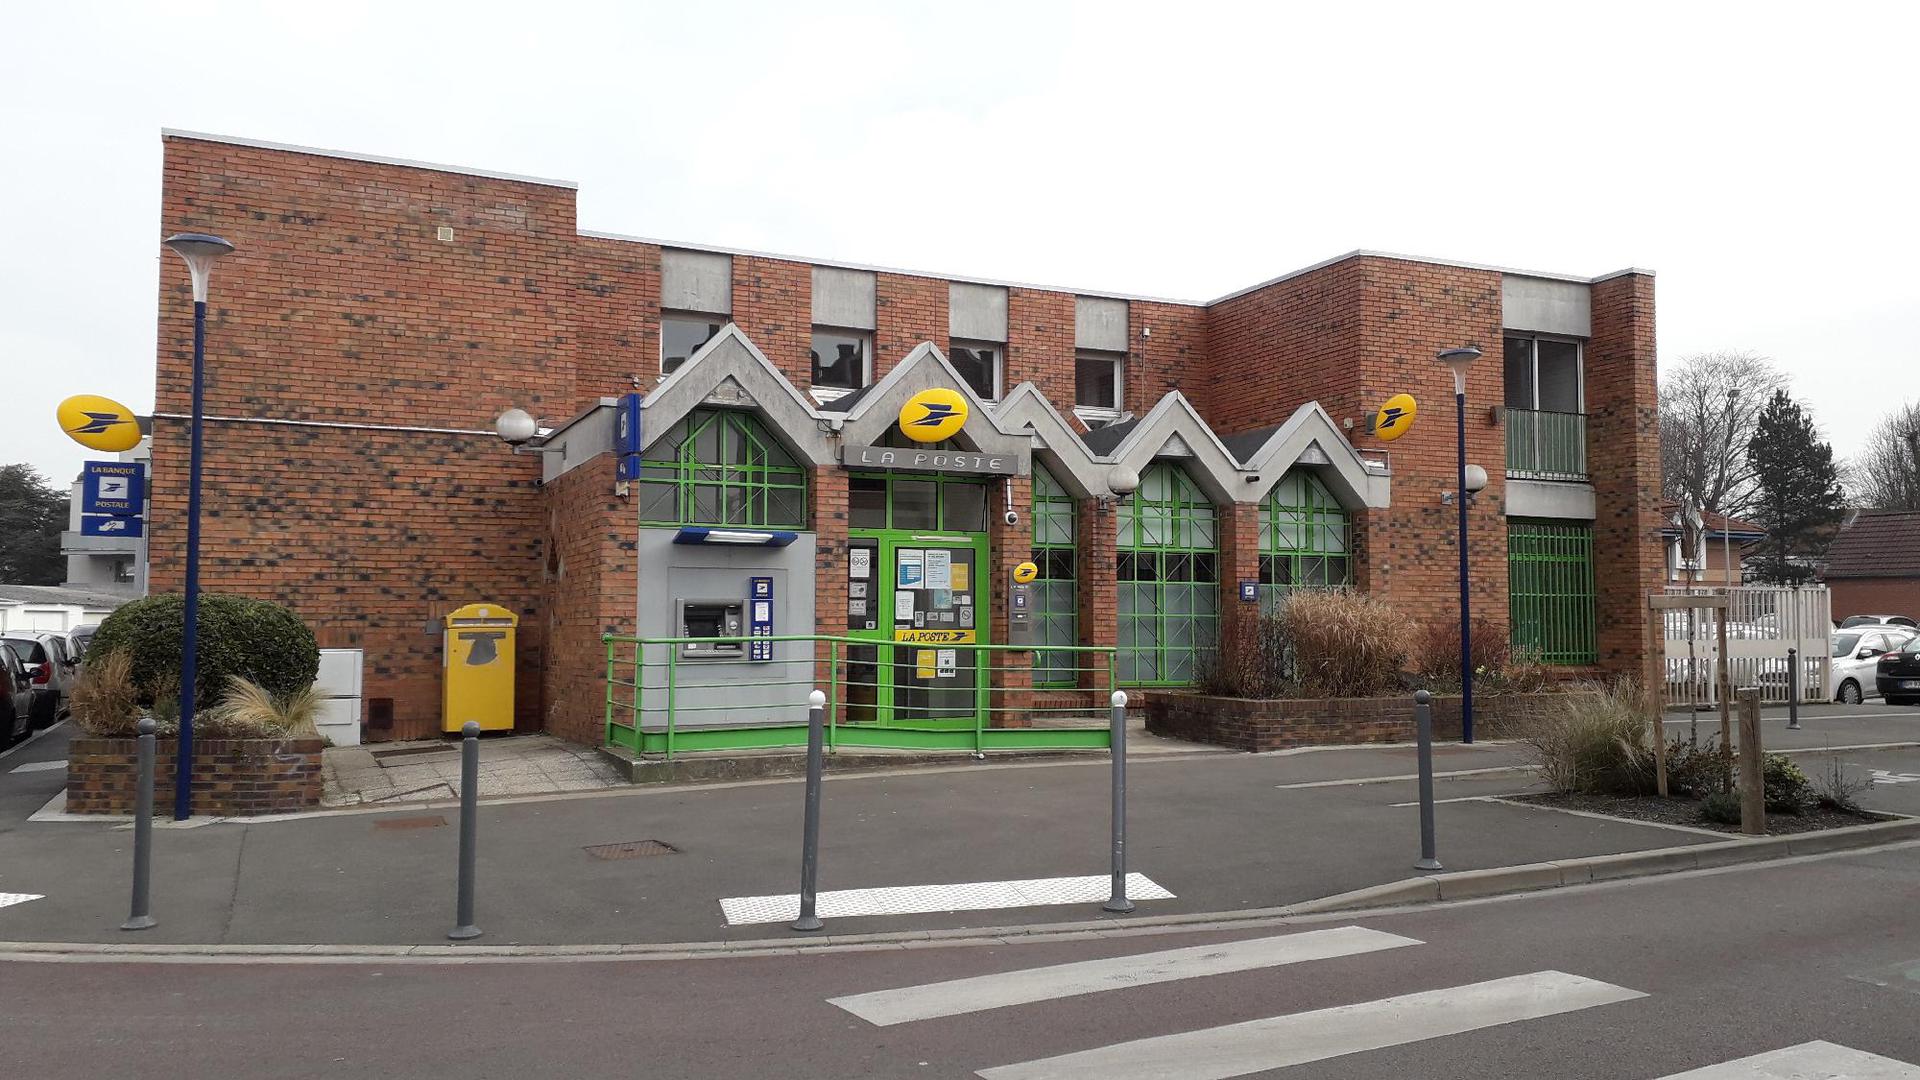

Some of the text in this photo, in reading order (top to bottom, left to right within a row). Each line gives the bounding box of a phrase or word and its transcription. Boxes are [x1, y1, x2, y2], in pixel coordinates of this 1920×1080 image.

[861, 450, 1003, 470] LA POSTE
[103, 467, 136, 475] BANQUE
[901, 632, 950, 642] LA POSTE
